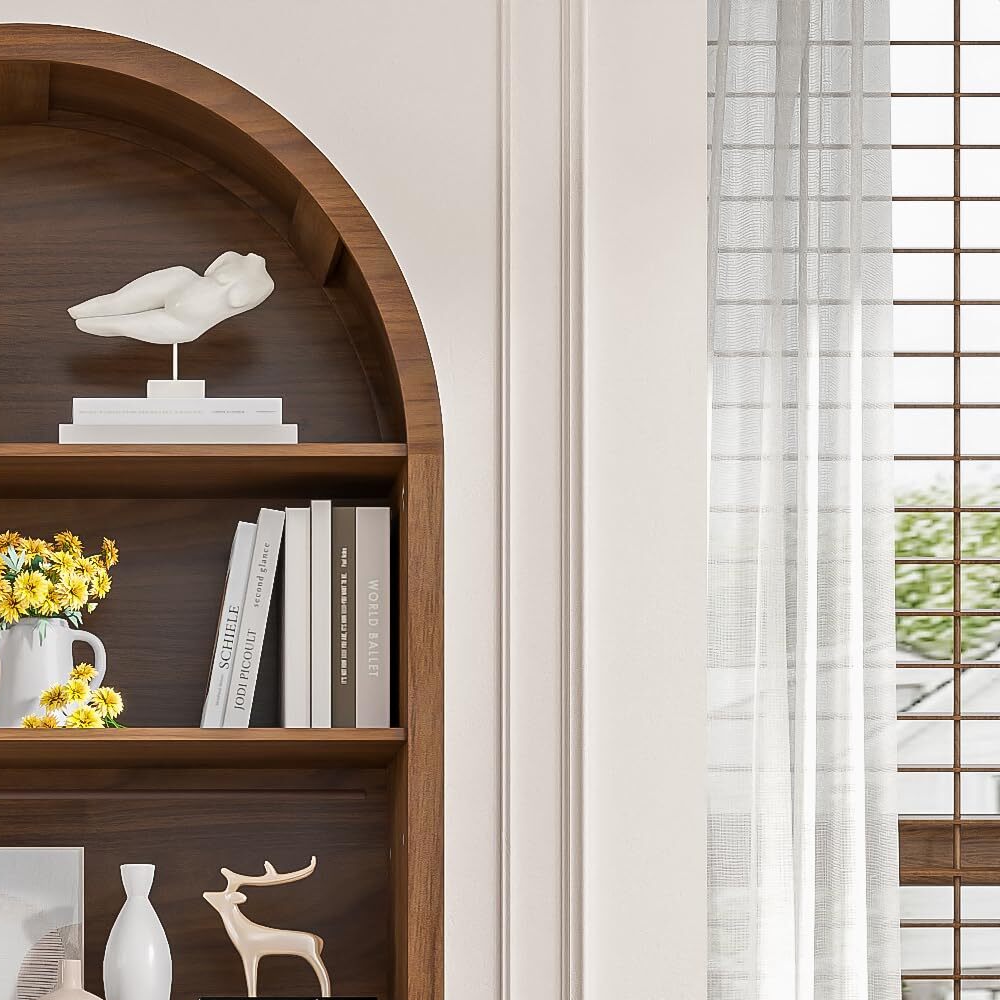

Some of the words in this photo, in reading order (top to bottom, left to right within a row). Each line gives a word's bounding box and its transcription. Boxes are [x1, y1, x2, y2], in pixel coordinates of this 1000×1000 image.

[258, 541, 271, 574] glance
[253, 575, 265, 608] second
[367, 579, 379, 627] WORLD
[219, 605, 240, 670] SCHIELE
[239, 628, 257, 680] PICOULT
[367, 632, 379, 678] BALLET
[234, 683, 248, 711] JODI
